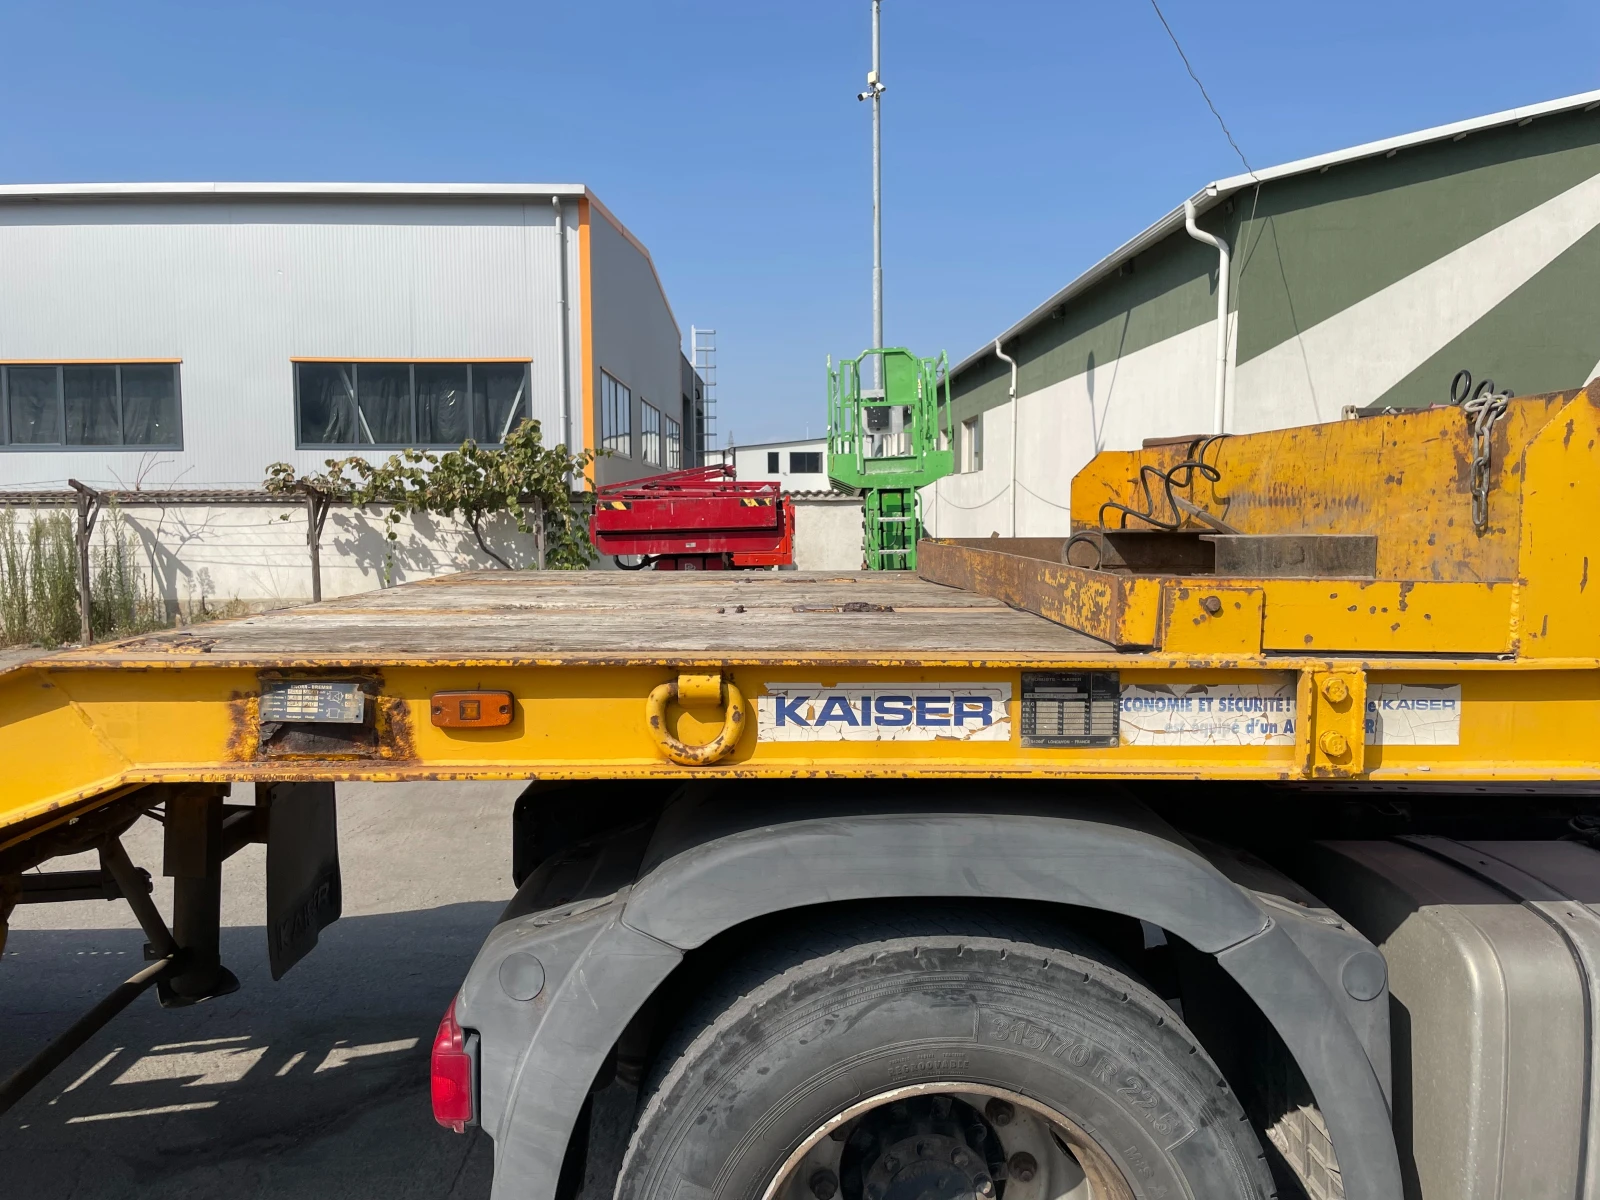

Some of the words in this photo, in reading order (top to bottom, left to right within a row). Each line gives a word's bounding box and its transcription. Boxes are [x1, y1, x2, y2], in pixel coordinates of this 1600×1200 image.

[775, 695, 993, 727] KAISER
[1199, 697, 1213, 712] ET
[1382, 700, 1456, 710] KAISER
[990, 1016, 1091, 1068] 315/70
[1092, 1056, 1118, 1086] R
[887, 1060, 970, 1077] REGROOVABLE
